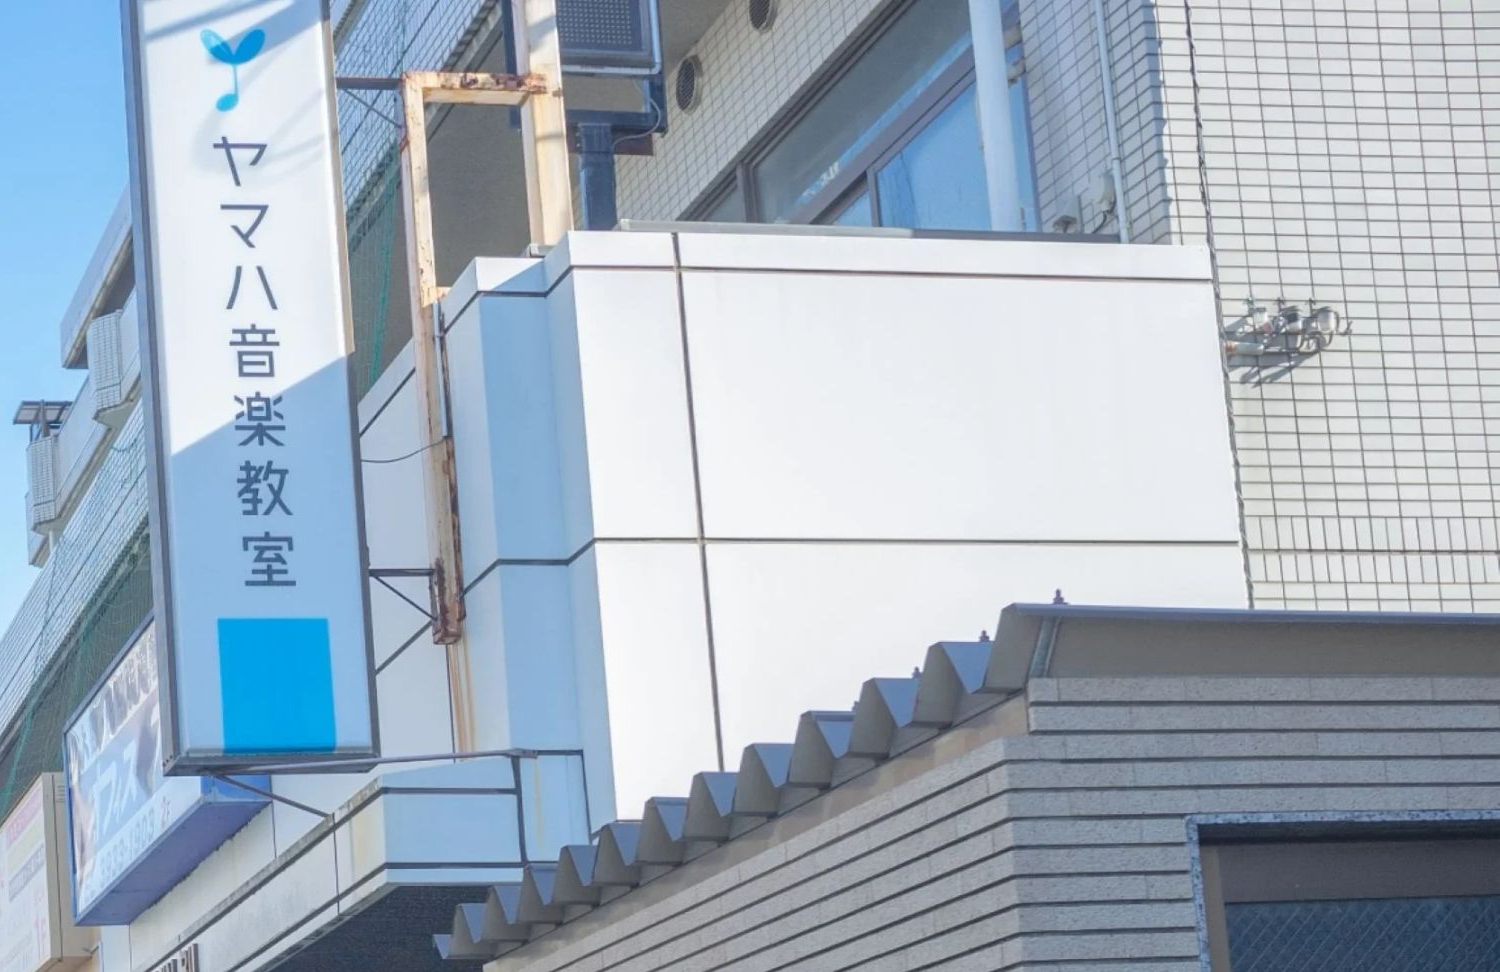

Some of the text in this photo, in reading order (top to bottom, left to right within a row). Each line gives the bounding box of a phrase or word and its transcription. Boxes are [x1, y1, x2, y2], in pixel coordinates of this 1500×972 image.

[213, 136, 297, 588] ヤマハ音楽教室
